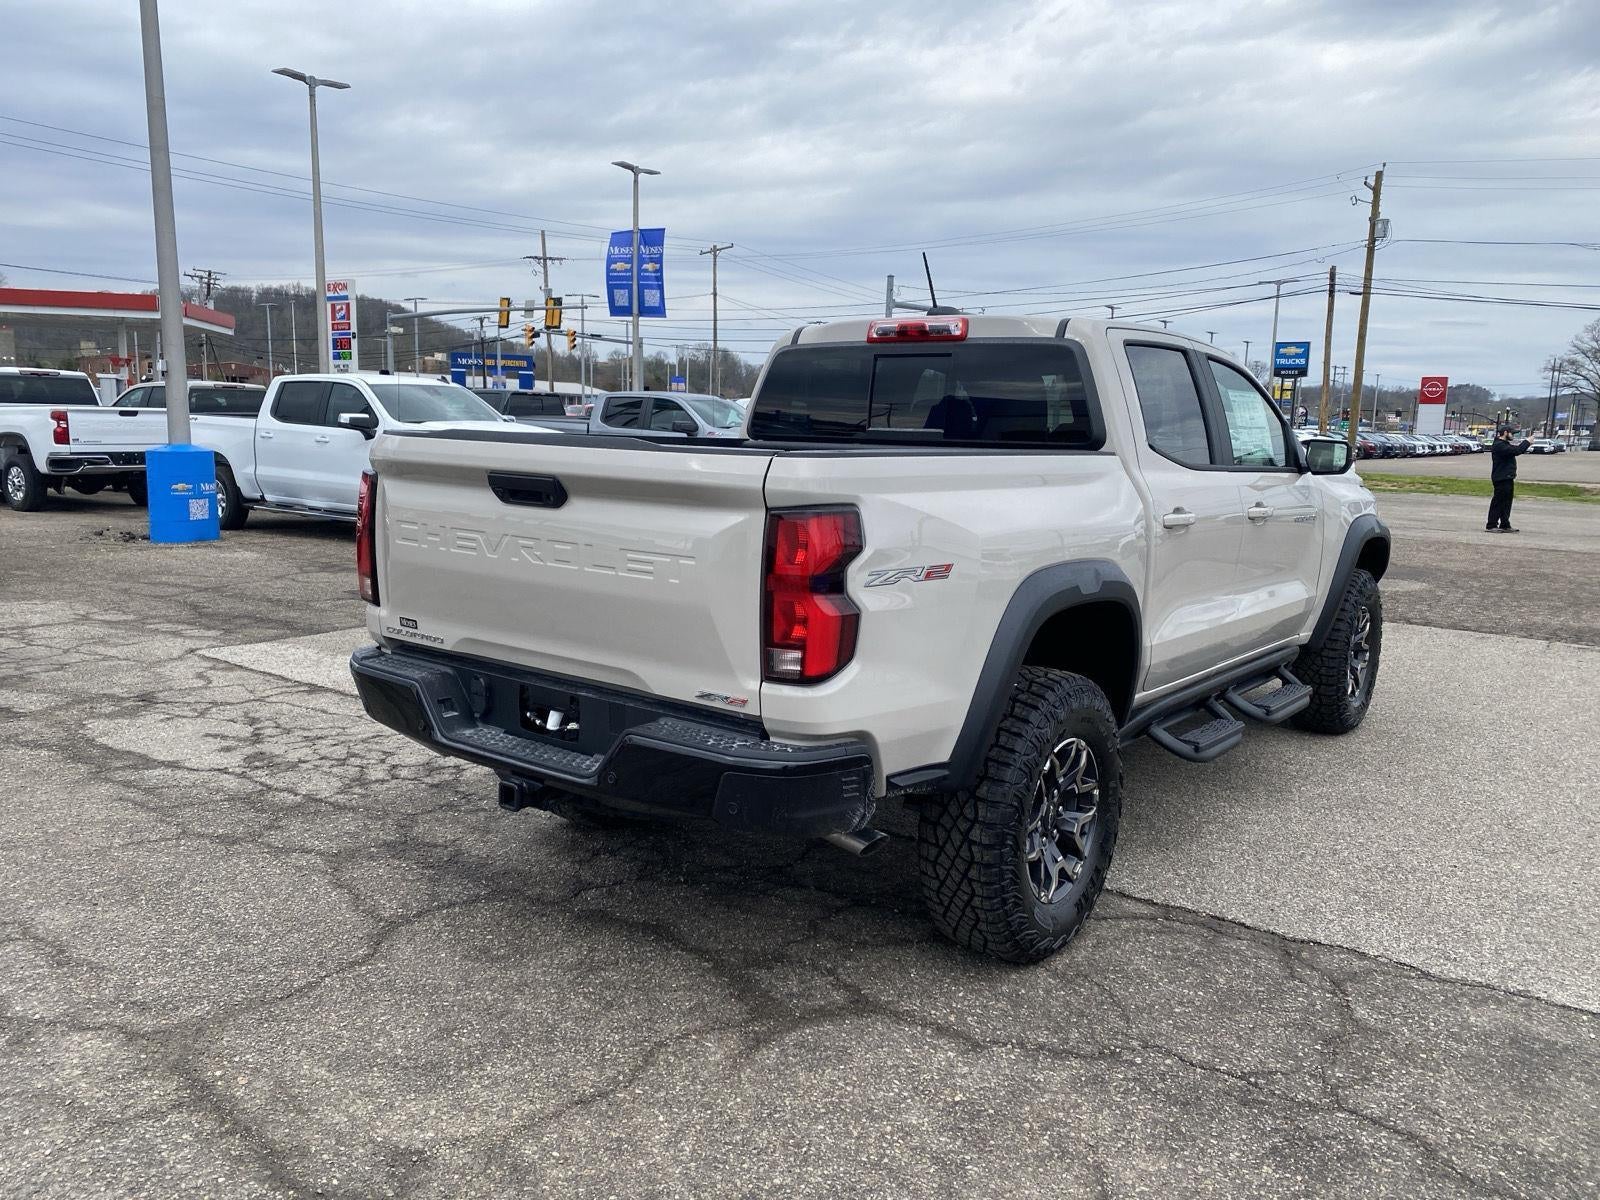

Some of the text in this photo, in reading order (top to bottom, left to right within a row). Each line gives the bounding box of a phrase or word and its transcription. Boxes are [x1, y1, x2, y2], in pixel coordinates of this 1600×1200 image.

[609, 246, 634, 255] MOSES
[640, 245, 663, 254] MOSES
[327, 282, 348, 294] EXXON
[457, 357, 484, 366] MOSES
[497, 360, 528, 368] UPERCENTER
[396, 519, 696, 583] CHEVROLET
[864, 564, 954, 588] ZR2
[386, 626, 444, 644] COLORADO
[694, 690, 748, 706] ZR2
